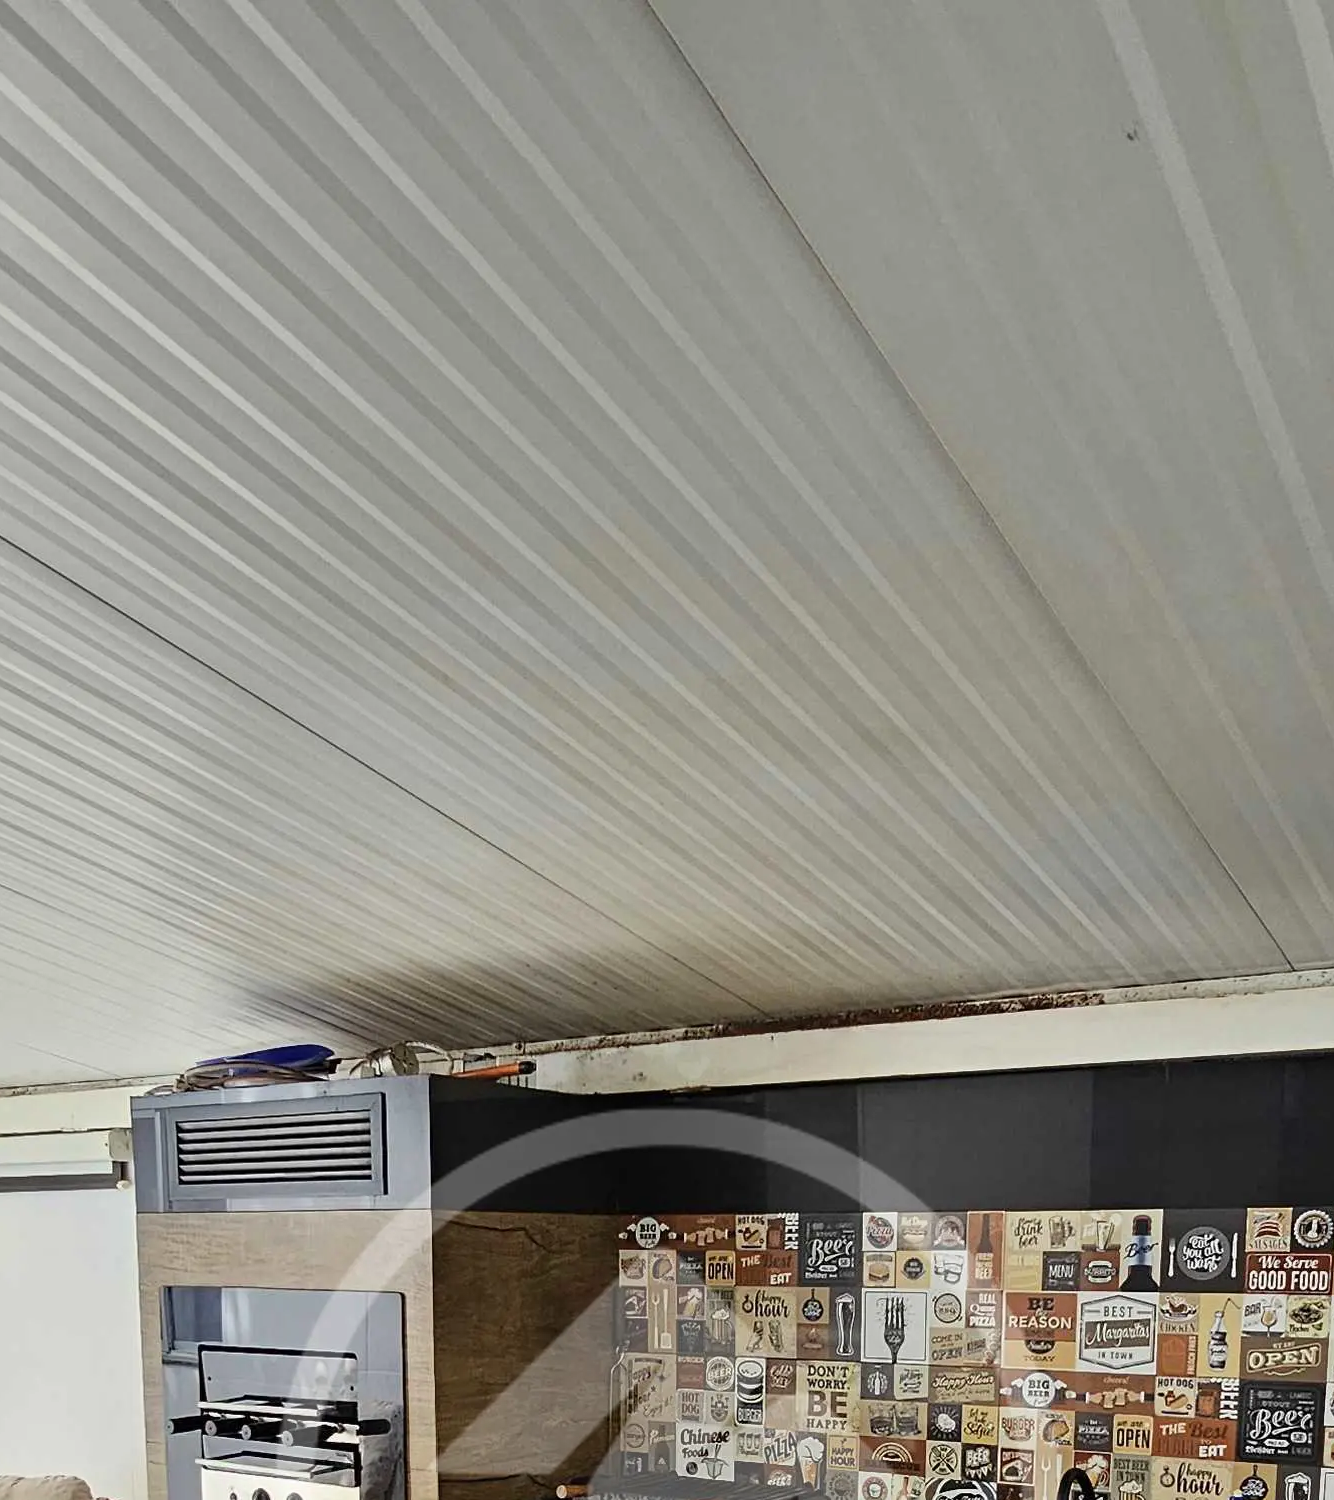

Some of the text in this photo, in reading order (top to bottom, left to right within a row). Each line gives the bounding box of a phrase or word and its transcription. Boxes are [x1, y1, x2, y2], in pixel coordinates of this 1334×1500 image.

[738, 1216, 749, 1225] HOT
[639, 1223, 657, 1233] BIG
[1014, 1221, 1043, 1237] drink
[1019, 1233, 1039, 1249] beer
[1190, 1234, 1214, 1249] eat
[1124, 1241, 1160, 1260] Beer
[1182, 1246, 1203, 1262] you
[740, 1255, 761, 1268] THE
[1187, 1256, 1220, 1273] want
[1258, 1256, 1319, 1269] We Serve
[708, 1262, 734, 1280] OPEN
[1049, 1264, 1074, 1278] MENU
[770, 1273, 792, 1285] EAT
[1248, 1270, 1329, 1291] GOOD FOOD
[754, 1289, 790, 1318] hour
[979, 1293, 997, 1305] REAL
[1028, 1297, 1055, 1311] BE
[1104, 1305, 1134, 1318] BEST
[1244, 1303, 1261, 1317] BAR
[969, 1316, 996, 1327] PIZZA
[1008, 1315, 1073, 1330] REASON
[931, 1333, 963, 1344] COME IN
[1085, 1322, 1151, 1347] Margaritas
[931, 1347, 964, 1361] OPEN
[1023, 1355, 1056, 1363] TODAY
[1098, 1351, 1134, 1360] IN TOWN
[1248, 1346, 1320, 1368] OPEN
[807, 1364, 850, 1378] DON'T
[932, 1375, 967, 1390] Happy
[967, 1372, 995, 1386] Hour
[1028, 1379, 1050, 1389] BIG
[1157, 1377, 1194, 1389] HOT DOG
[682, 1392, 699, 1401] HOT
[1027, 1390, 1050, 1398] BEER
[681, 1404, 700, 1414] DOG
[807, 1390, 848, 1418] BE
[806, 1419, 848, 1430] HAPPY
[1002, 1416, 1035, 1430] BURGER
[1159, 1422, 1186, 1435] THE
[1249, 1407, 1313, 1441] Beer
[680, 1429, 730, 1446] Chinese
[1117, 1428, 1151, 1449] OPEN
[682, 1447, 709, 1458] Foods
[764, 1431, 797, 1463] PIZZA
[832, 1446, 854, 1456] HAPPY
[1199, 1444, 1227, 1458] EAT
[830, 1457, 855, 1466] HOUR
[966, 1448, 988, 1466] BEER
[1114, 1458, 1150, 1471] BEST BEER
[1176, 1462, 1225, 1497] hour
